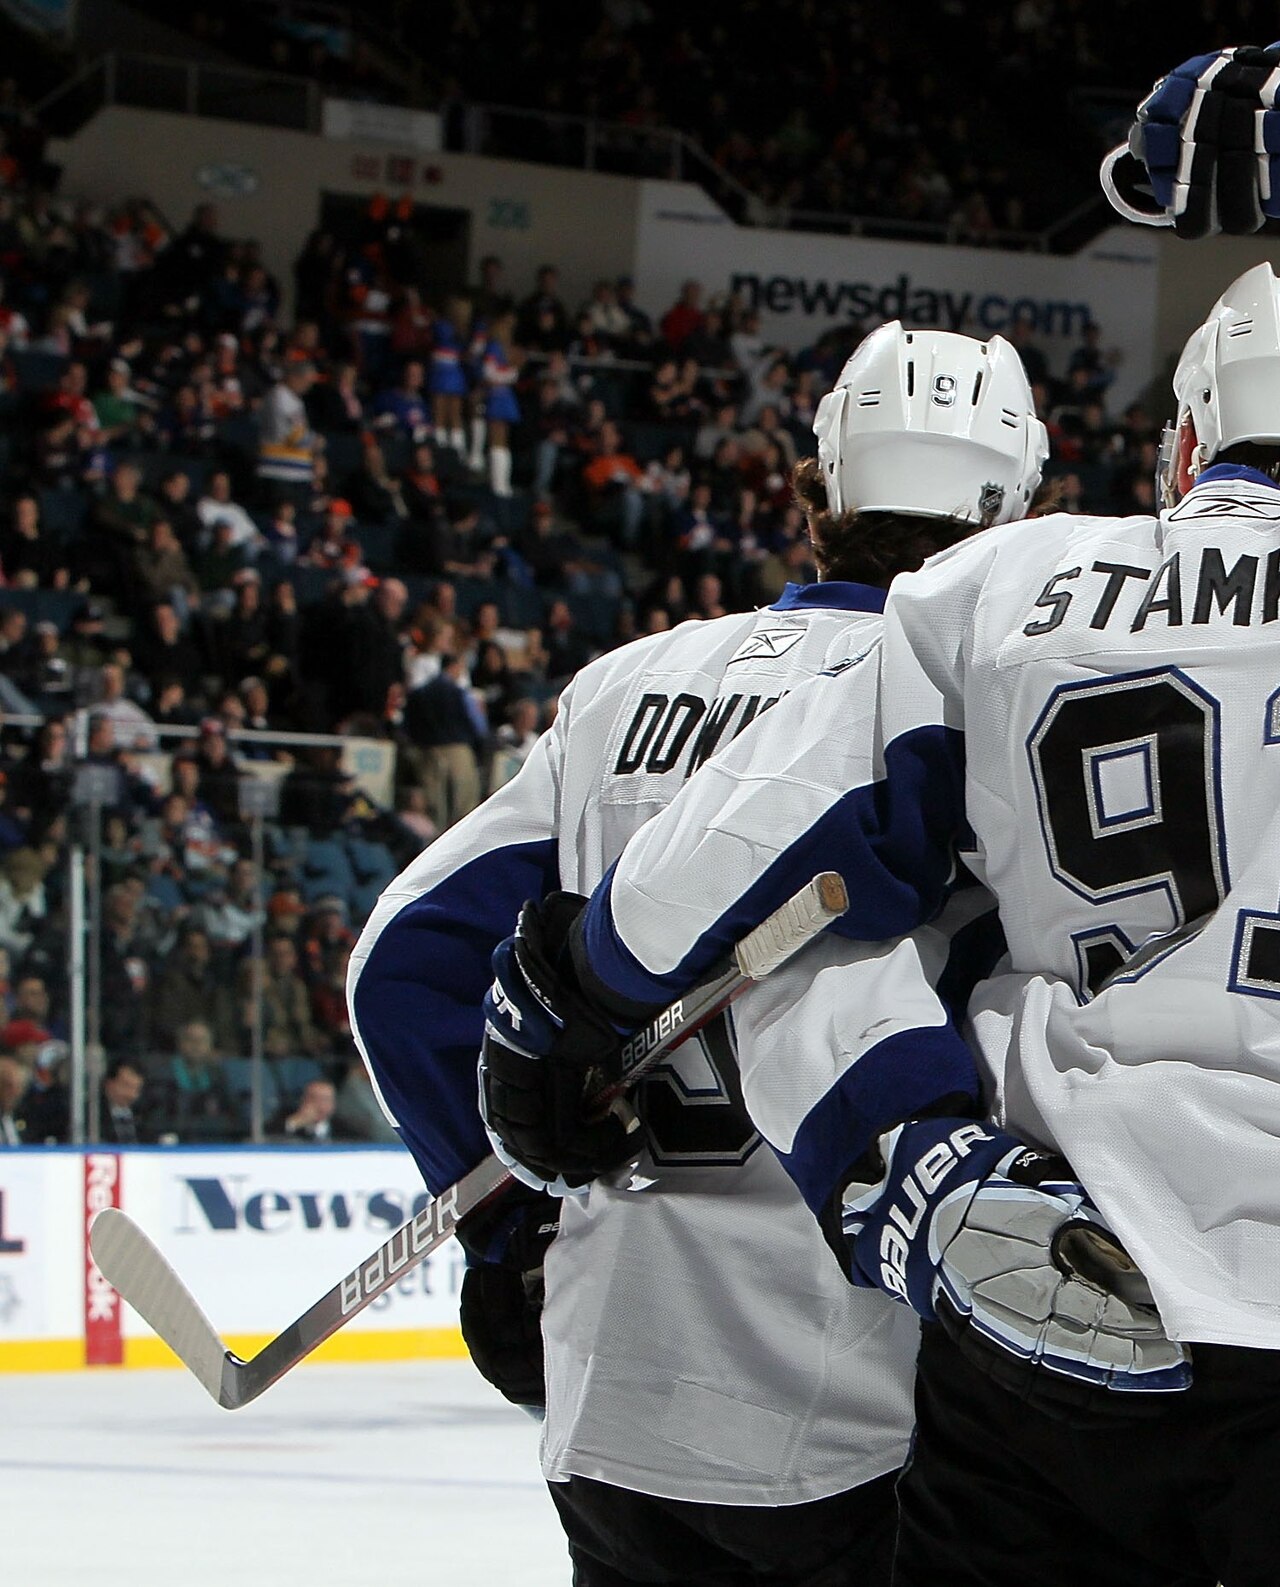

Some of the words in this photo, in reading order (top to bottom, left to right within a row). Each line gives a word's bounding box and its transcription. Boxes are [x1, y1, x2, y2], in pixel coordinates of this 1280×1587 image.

[730, 271, 1090, 337] newsday.com
[930, 373, 958, 408] 9
[621, 999, 685, 1070] BAUER
[86, 1154, 119, 1322] Reok
[340, 1183, 462, 1315] BAUER
[878, 1124, 996, 1307] BAUER
